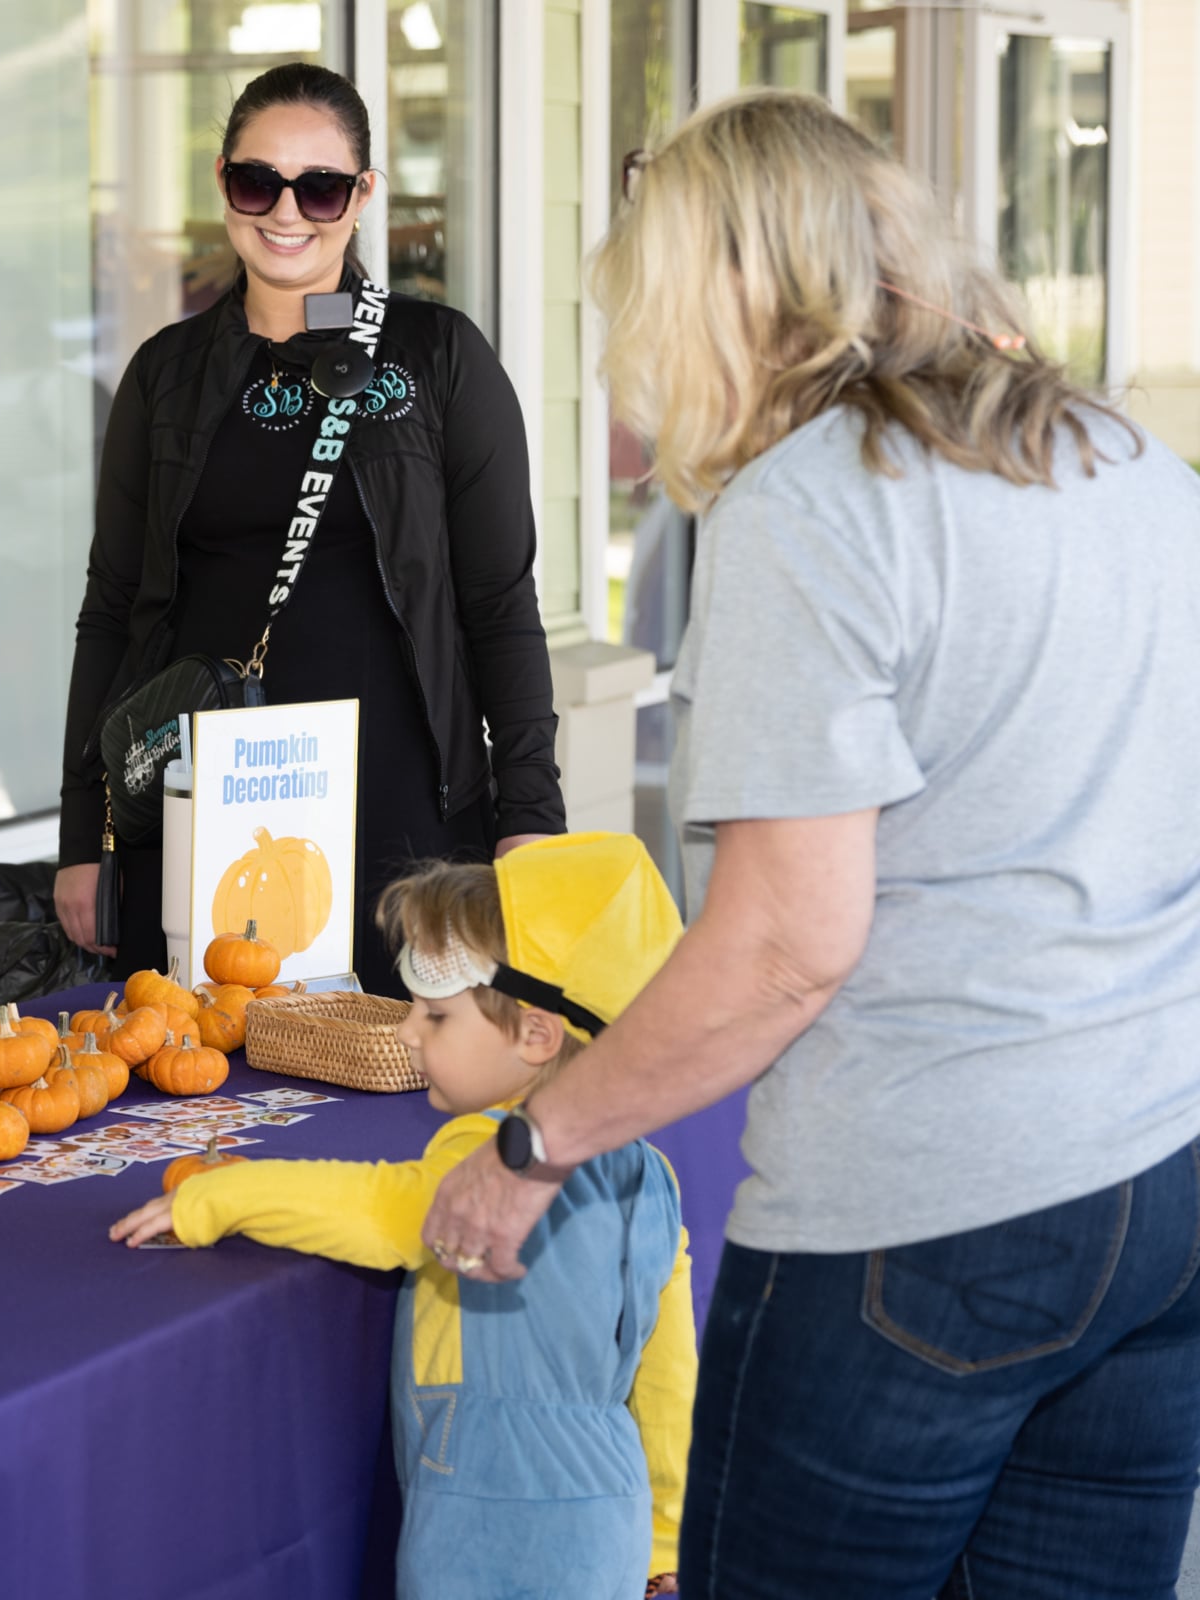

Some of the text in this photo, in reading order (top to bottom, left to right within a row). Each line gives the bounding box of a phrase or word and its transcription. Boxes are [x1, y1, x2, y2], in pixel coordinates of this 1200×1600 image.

[268, 397, 357, 606] S&B EVENTS
[150, 731, 182, 761] Brillia
[234, 731, 318, 770] Pumpkin
[222, 766, 328, 805] Decorating
